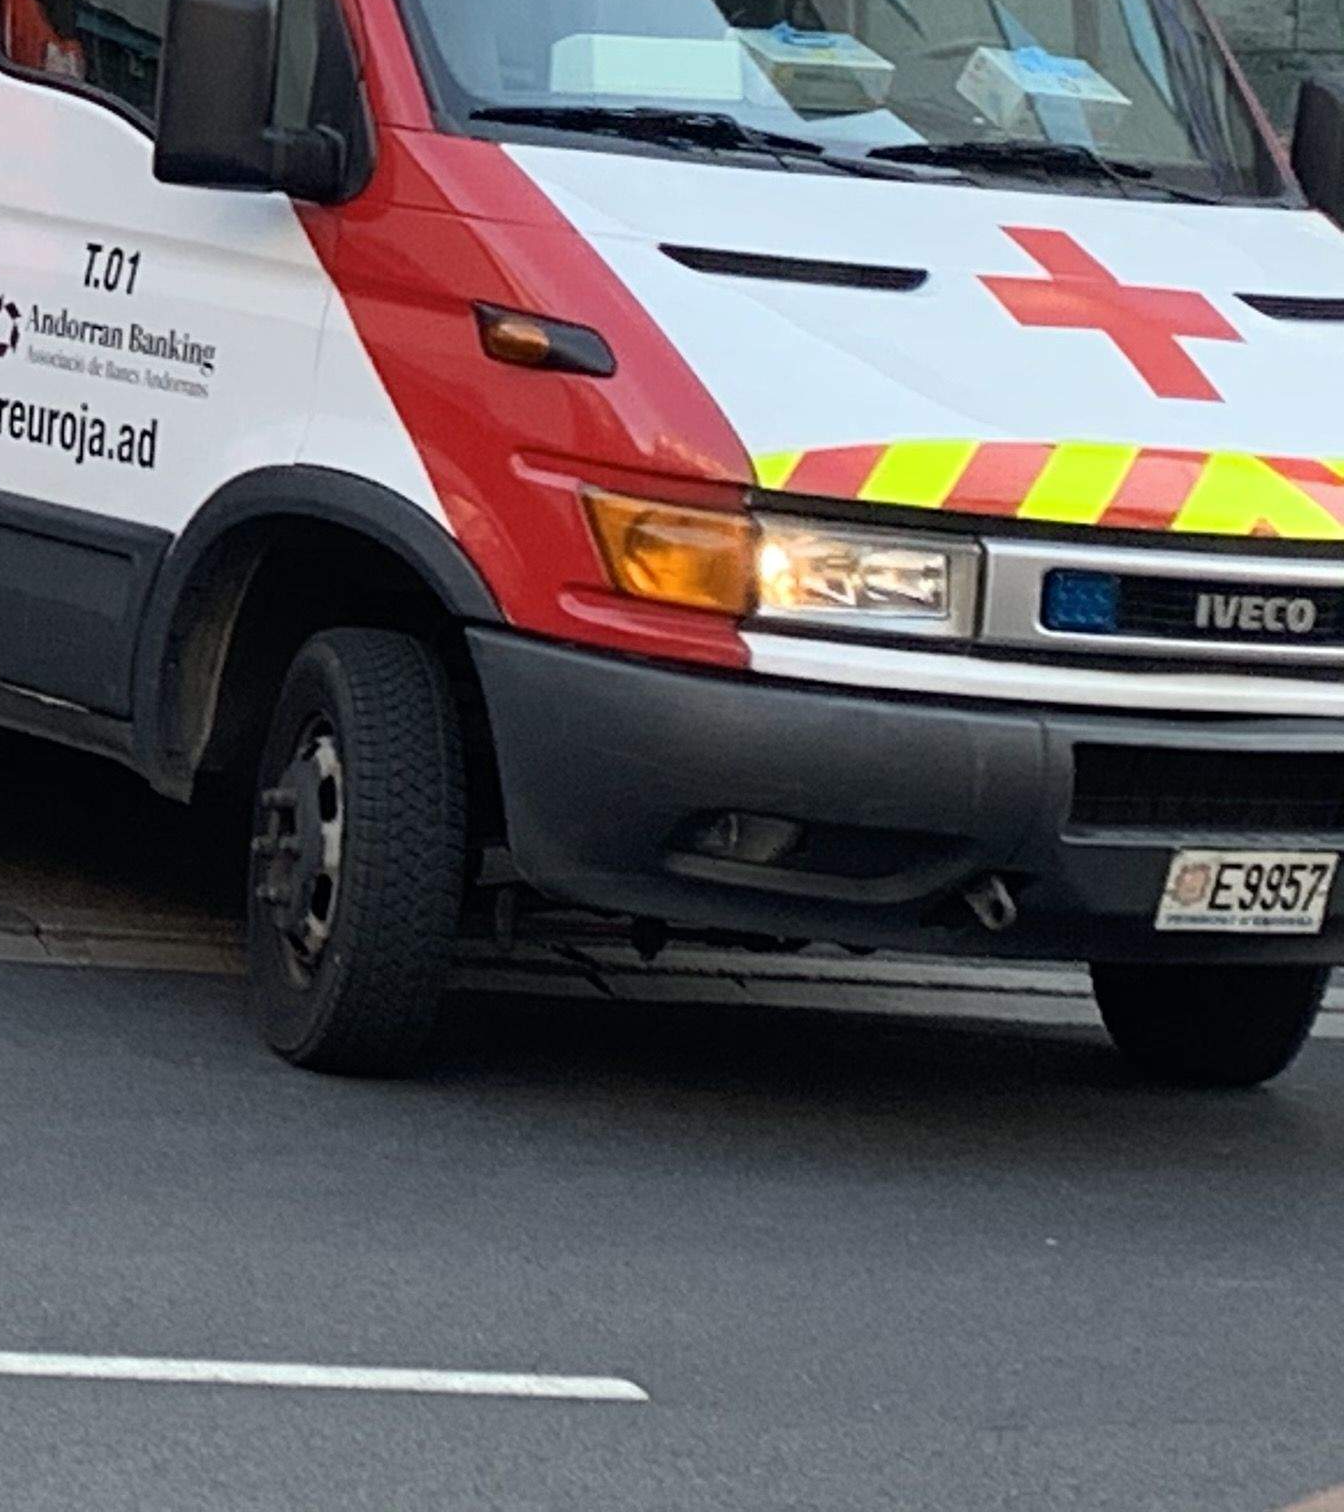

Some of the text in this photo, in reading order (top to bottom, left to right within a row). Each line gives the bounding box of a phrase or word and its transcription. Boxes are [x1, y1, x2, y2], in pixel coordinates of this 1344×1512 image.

[83, 242, 141, 295] T.01
[25, 304, 216, 377] Andorran Banking
[1195, 593, 1317, 633] IVECO
[1207, 862, 1330, 912] E9957
